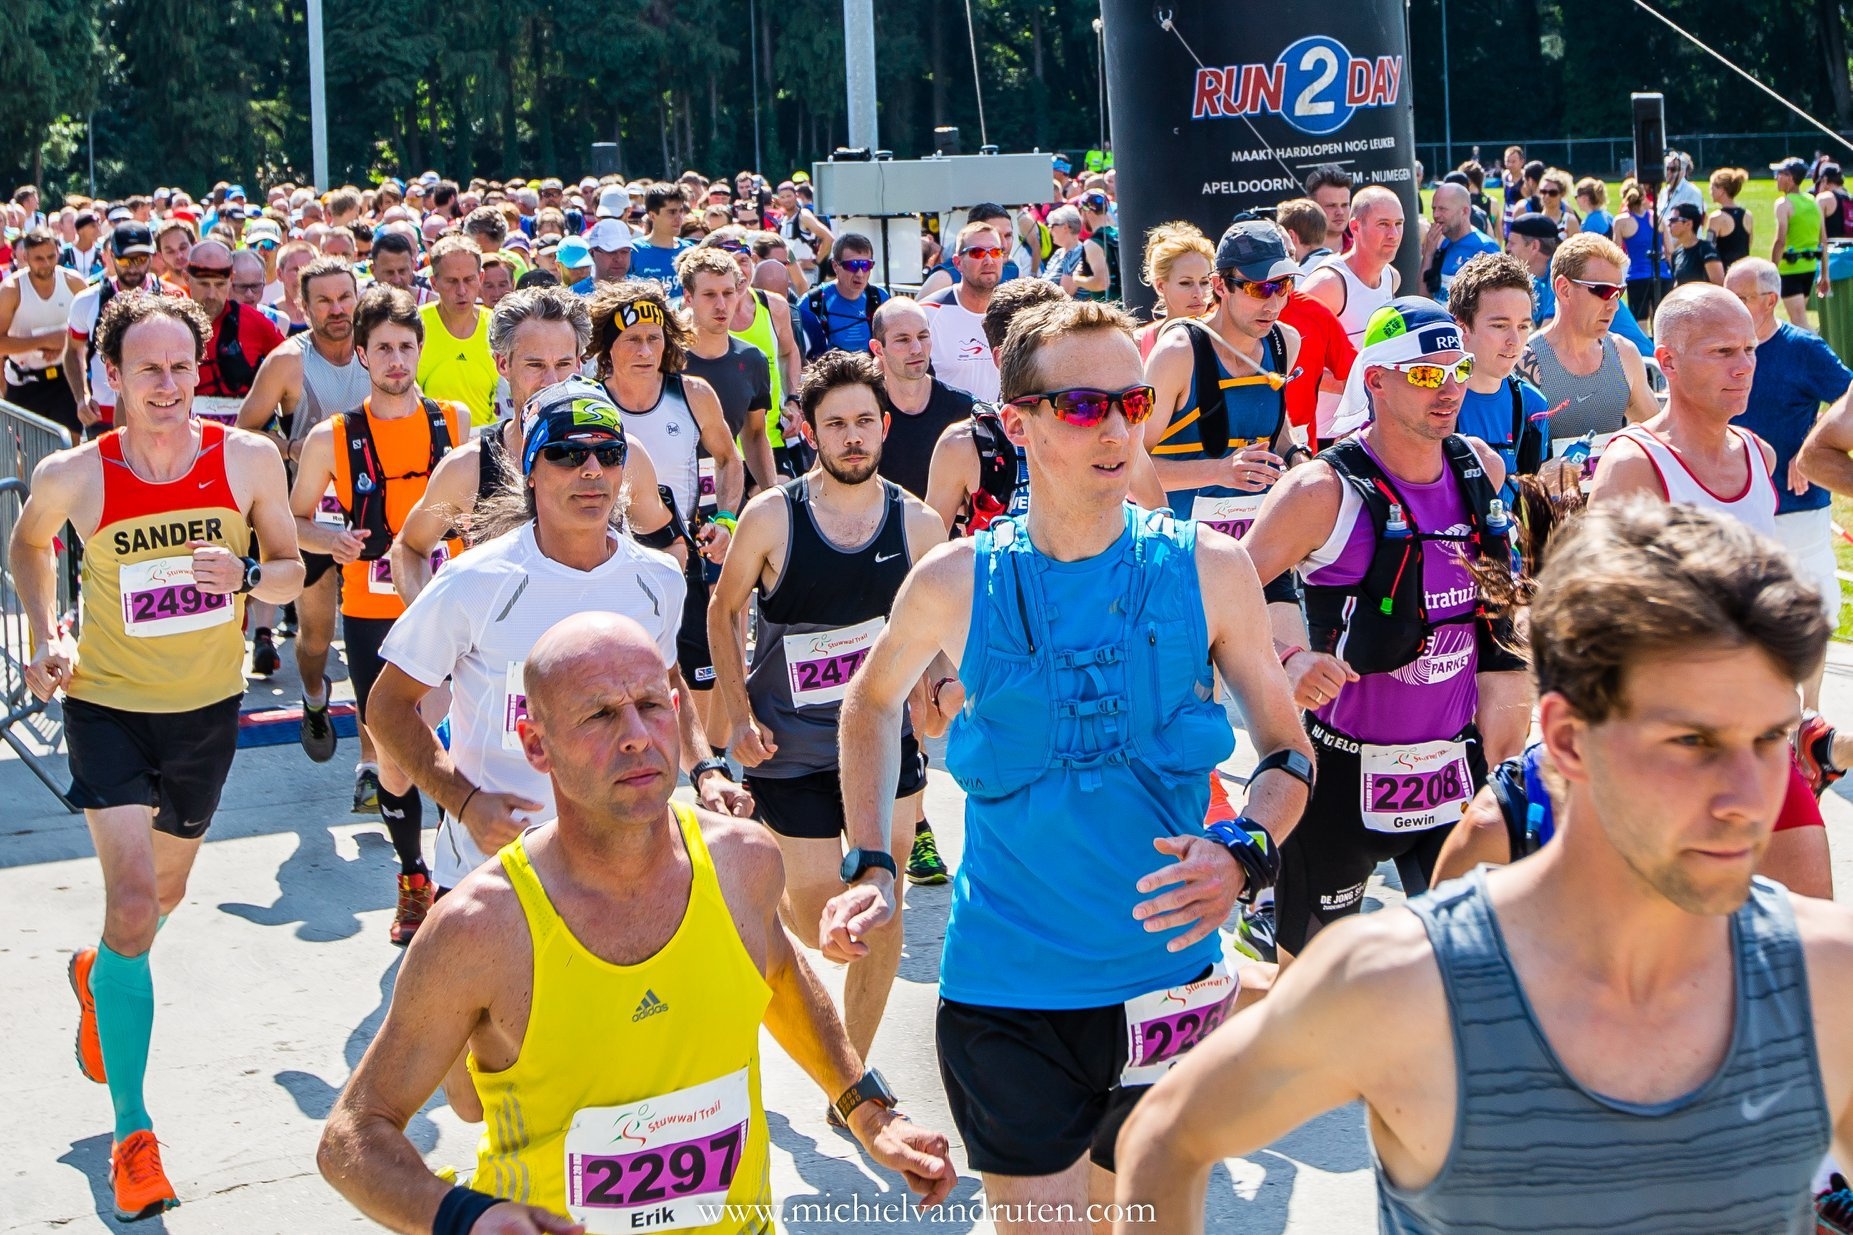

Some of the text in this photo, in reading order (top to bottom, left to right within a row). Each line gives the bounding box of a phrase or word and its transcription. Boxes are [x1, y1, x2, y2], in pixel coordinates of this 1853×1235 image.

[1231, 136, 1396, 163] MAAKT HARDLOPEN NOG LEUKER
[1201, 177, 1295, 195] APELDOORN
[1371, 167, 1412, 183] NIJMEGEN
[113, 517, 223, 556] SANDER
[166, 568, 194, 577] Stuwwa
[133, 585, 224, 621] 2498
[1424, 581, 1480, 610] tratui
[827, 632, 868, 650] Stuwwal Trail
[799, 652, 869, 690] 247
[1374, 764, 1461, 810] 2208
[1393, 813, 1435, 829] Gewin
[1320, 895, 1333, 905] DE
[1333, 891, 1354, 904] JONG
[632, 1003, 669, 1023] adidas
[647, 1099, 721, 1134] Stuwwal Trail
[586, 1129, 740, 1205] 2297
[631, 1206, 675, 1228] Erik
